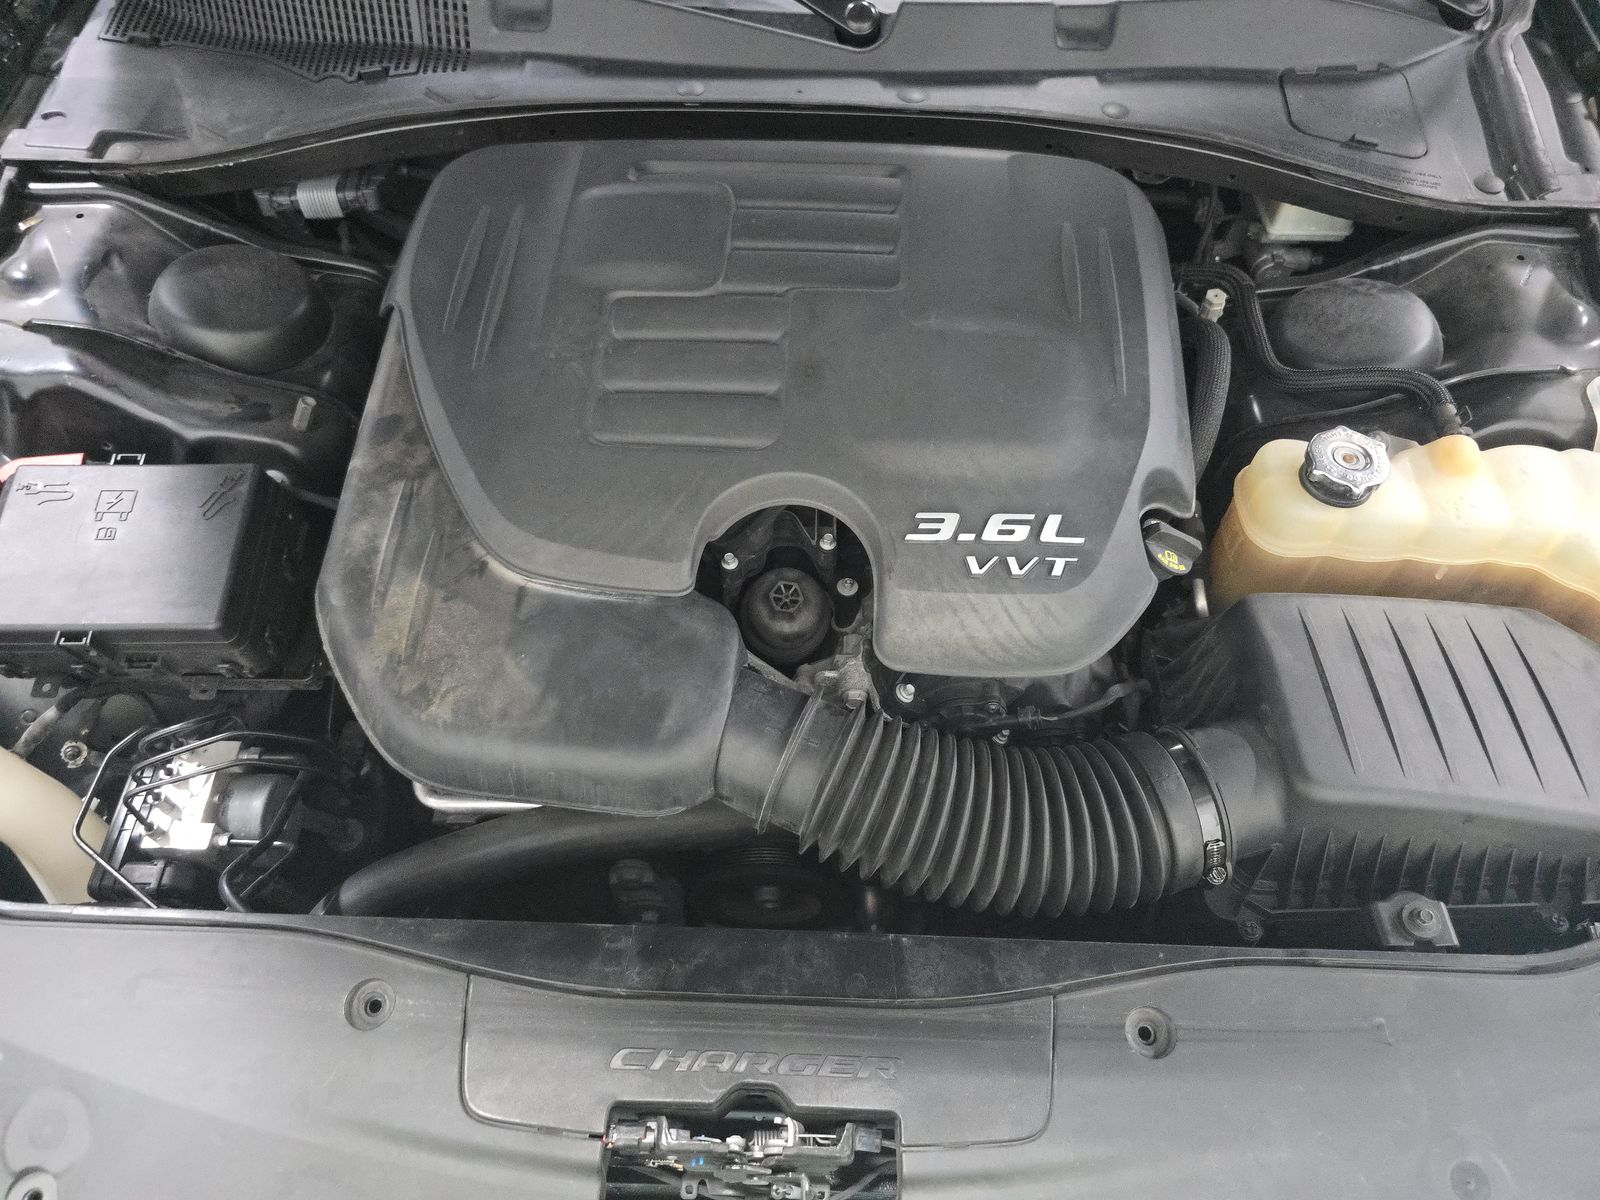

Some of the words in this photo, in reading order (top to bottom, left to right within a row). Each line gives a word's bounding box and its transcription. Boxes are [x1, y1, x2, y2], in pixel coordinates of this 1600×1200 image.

[904, 512, 1086, 544] 3.6L
[965, 556, 1079, 578] VVT
[608, 1047, 902, 1080] CHARGER
